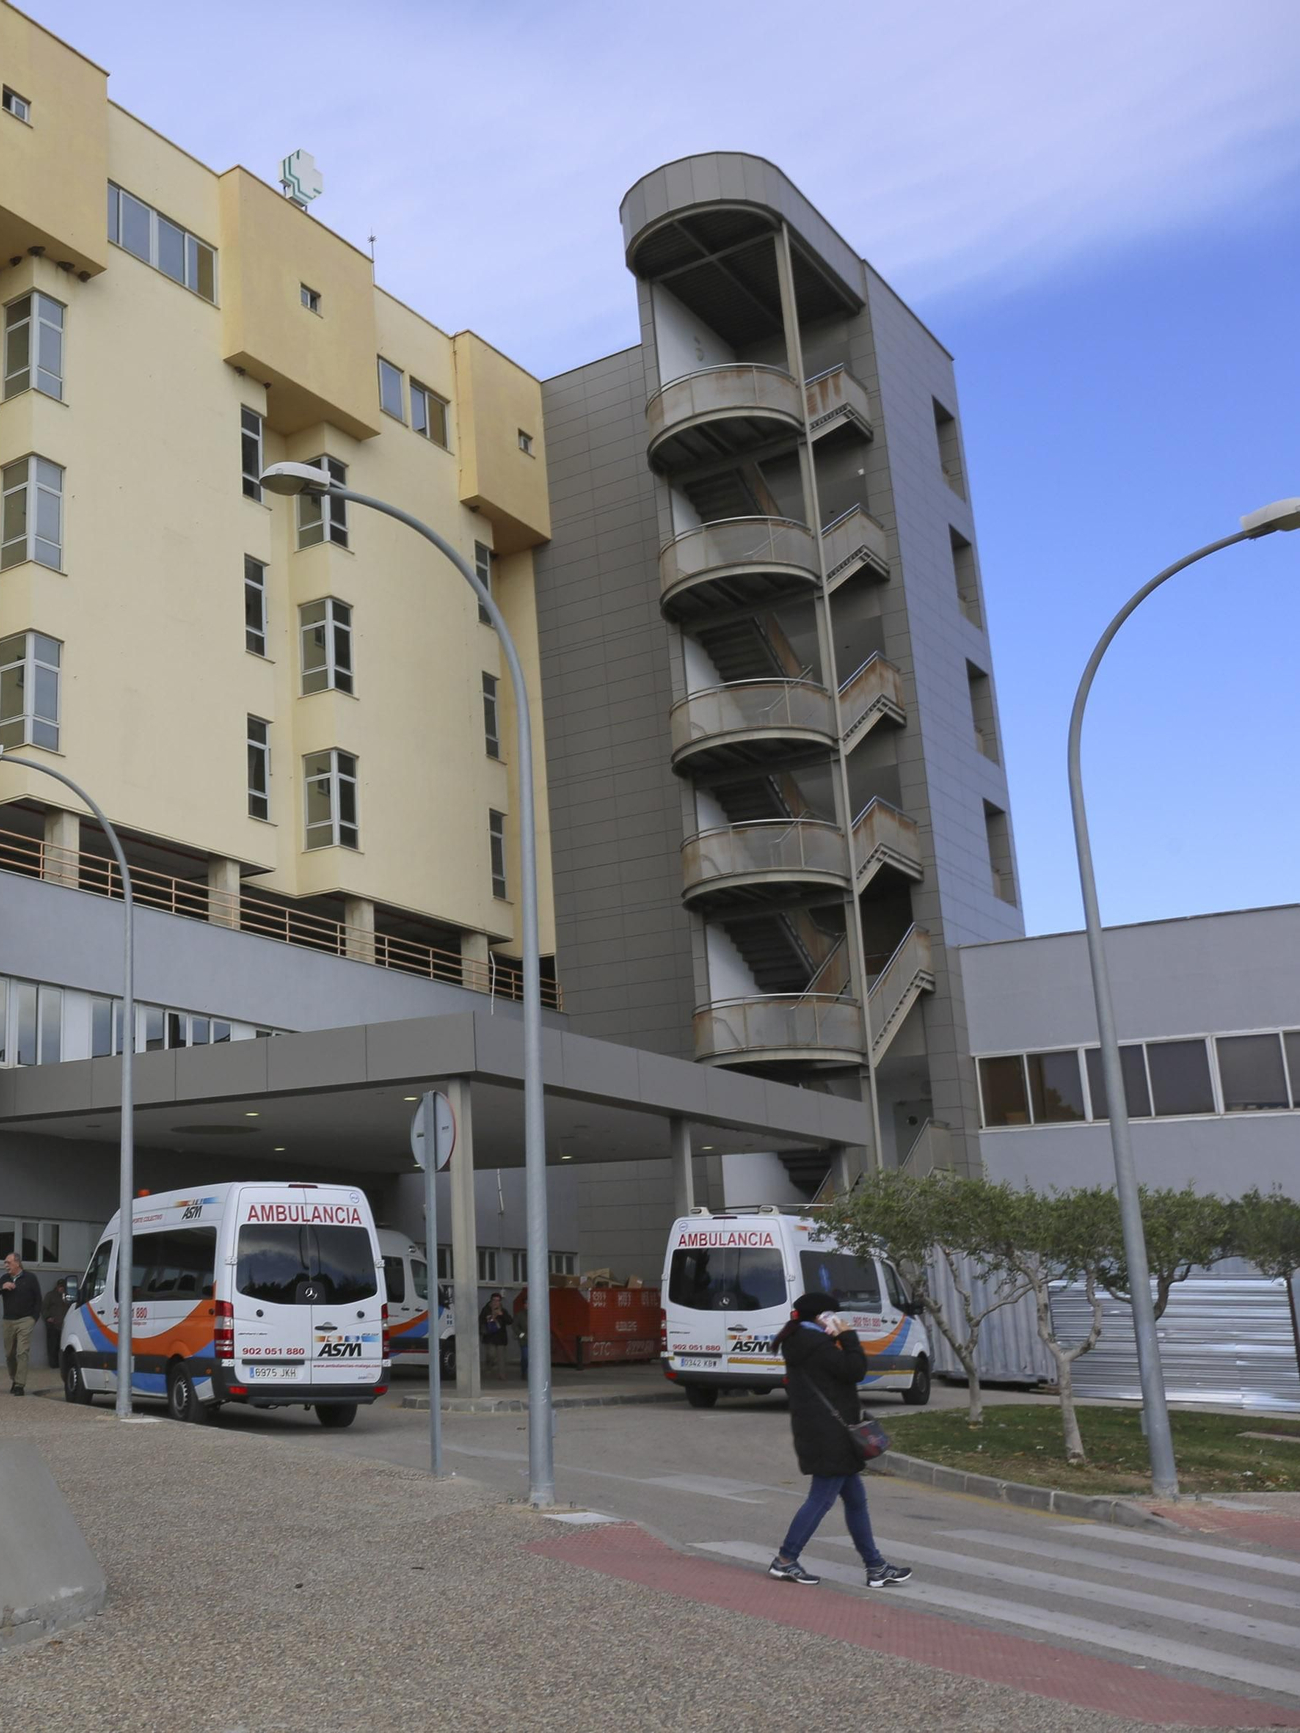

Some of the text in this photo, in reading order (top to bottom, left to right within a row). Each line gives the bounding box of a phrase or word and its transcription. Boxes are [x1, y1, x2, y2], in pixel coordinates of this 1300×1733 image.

[182, 1206, 203, 1220] ASM
[247, 1204, 362, 1225] AMBULANCIA
[678, 1232, 774, 1247] AMBULANCIA
[242, 1347, 305, 1356] 902 051 880
[317, 1343, 362, 1357] ASM
[672, 1343, 687, 1351] 902
[705, 1344, 721, 1352] 880
[731, 1340, 771, 1353] ASM
[255, 1368, 297, 1378] 6975 JKH
